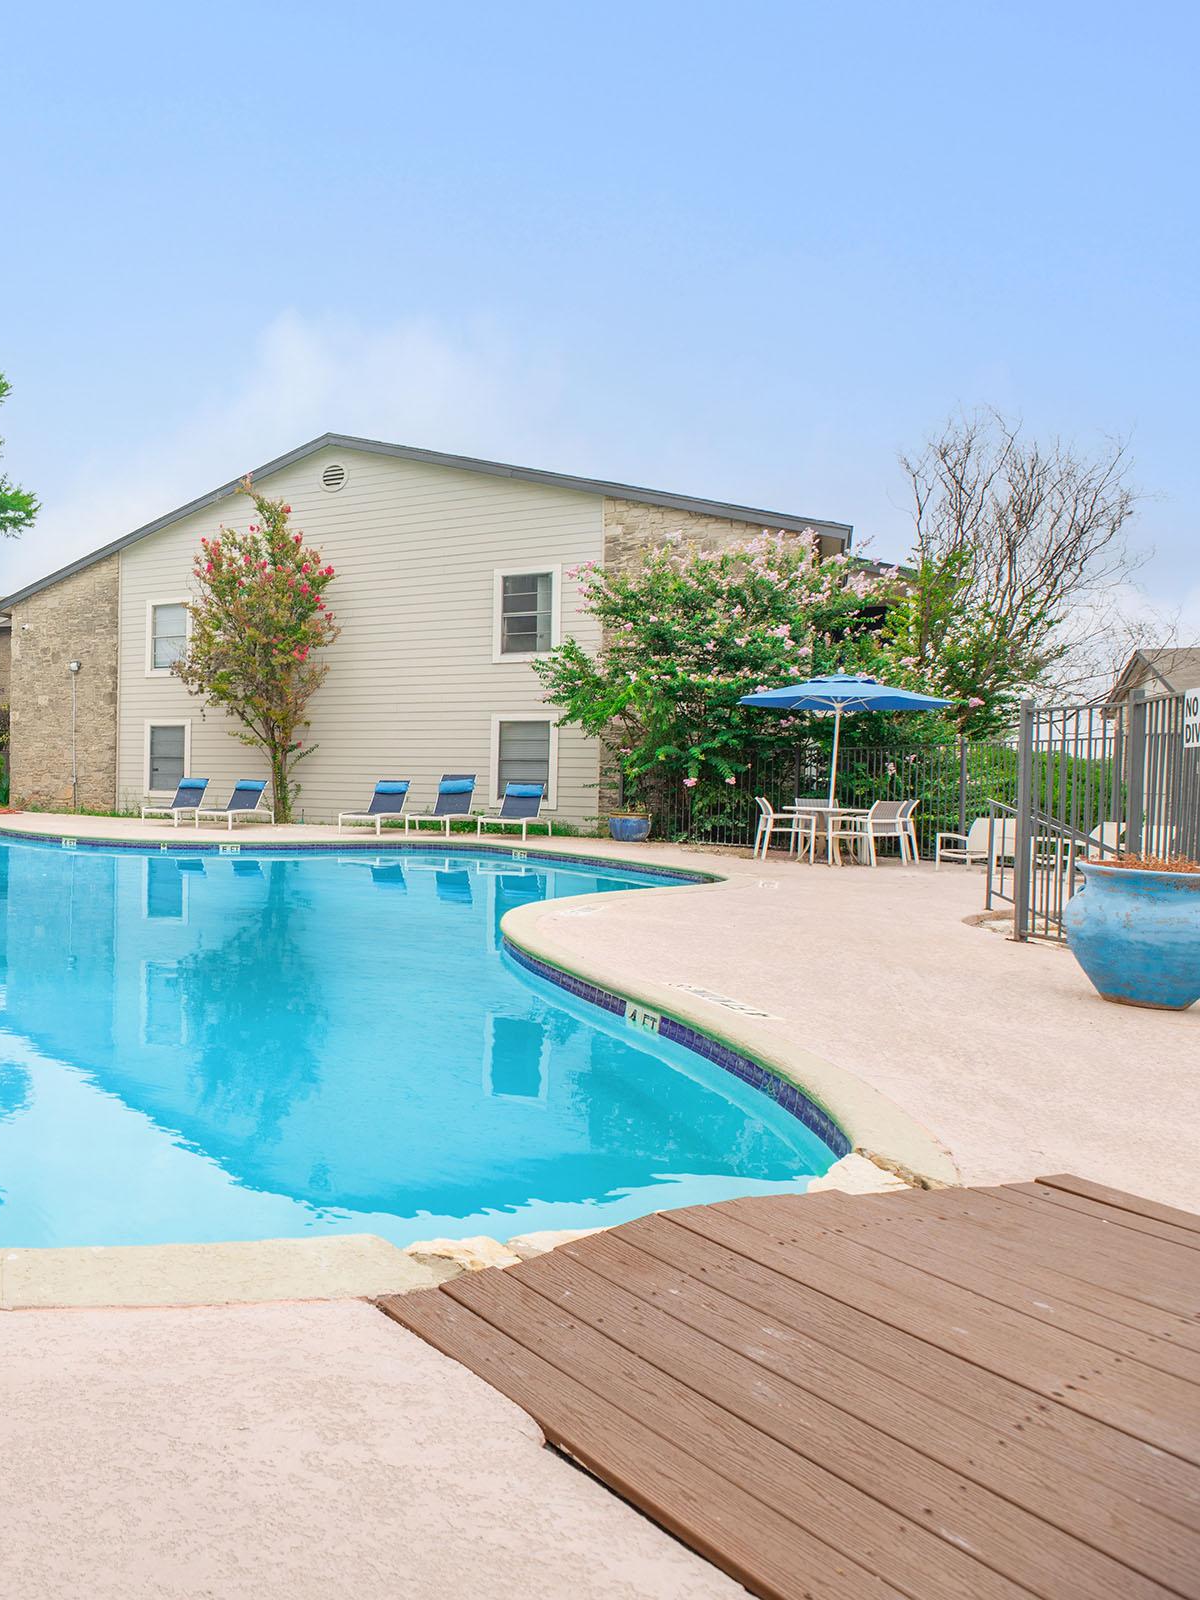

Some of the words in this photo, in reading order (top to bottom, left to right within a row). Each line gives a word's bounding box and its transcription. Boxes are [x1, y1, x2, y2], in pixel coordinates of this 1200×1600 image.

[1185, 697, 1199, 717] NO
[629, 1009, 638, 1021] 4
[642, 1013, 657, 1030] FT
